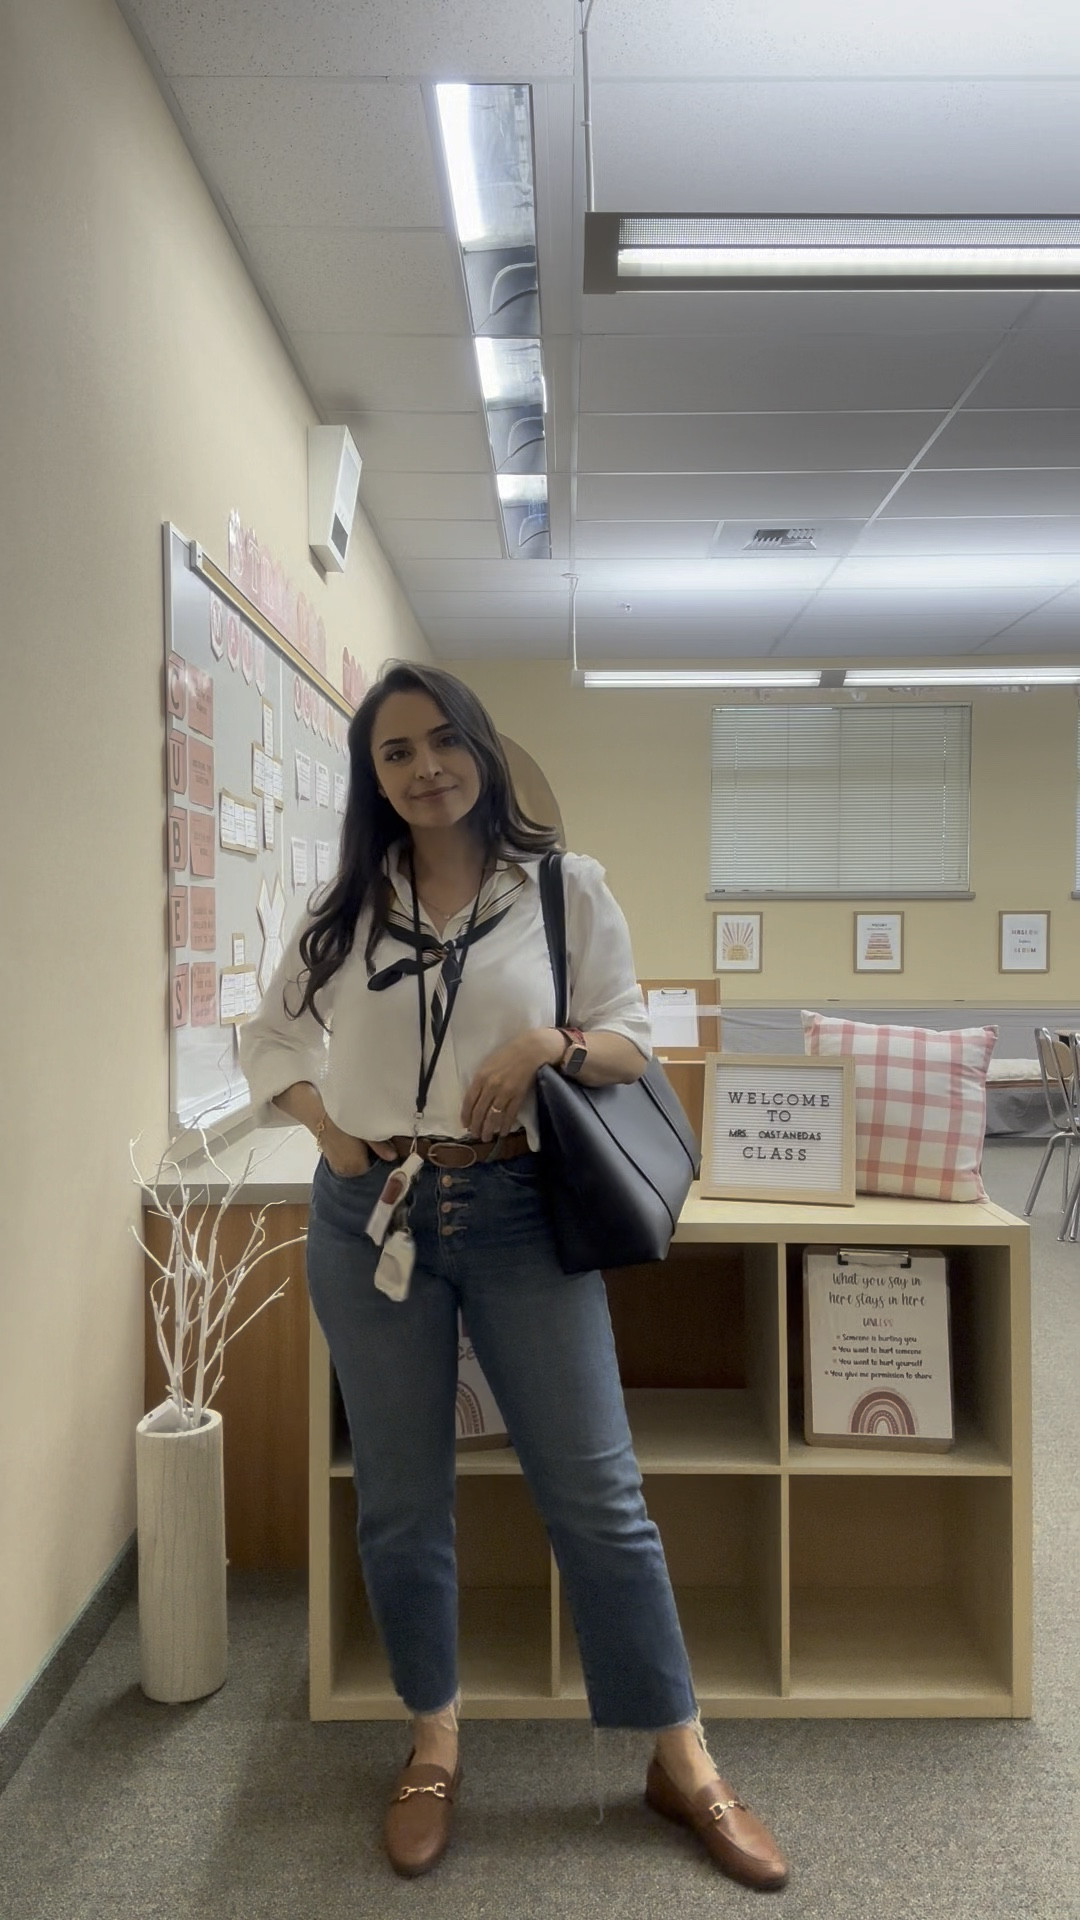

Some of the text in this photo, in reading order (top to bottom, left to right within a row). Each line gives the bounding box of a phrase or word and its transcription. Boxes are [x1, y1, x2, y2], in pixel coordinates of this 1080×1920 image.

[172, 743, 180, 786] U
[173, 821, 181, 863] B
[175, 979, 183, 1020] S
[727, 1092, 830, 1107] WELCOME
[767, 1109, 791, 1122] TO
[742, 1146, 807, 1161] CLASS
[832, 1272, 922, 1290] What you say in
[829, 1291, 925, 1309] here stays in here
[842, 1333, 870, 1342] Someone
[878, 1335, 903, 1346] hurting
[904, 1337, 917, 1346] you
[838, 1345, 852, 1353] You
[853, 1346, 869, 1354] want
[839, 1358, 852, 1366] You
[880, 1359, 894, 1367] hurt
[896, 1360, 923, 1371] yourself
[844, 1371, 859, 1380] give
[870, 1371, 905, 1380] permission
[914, 1372, 933, 1380] share
